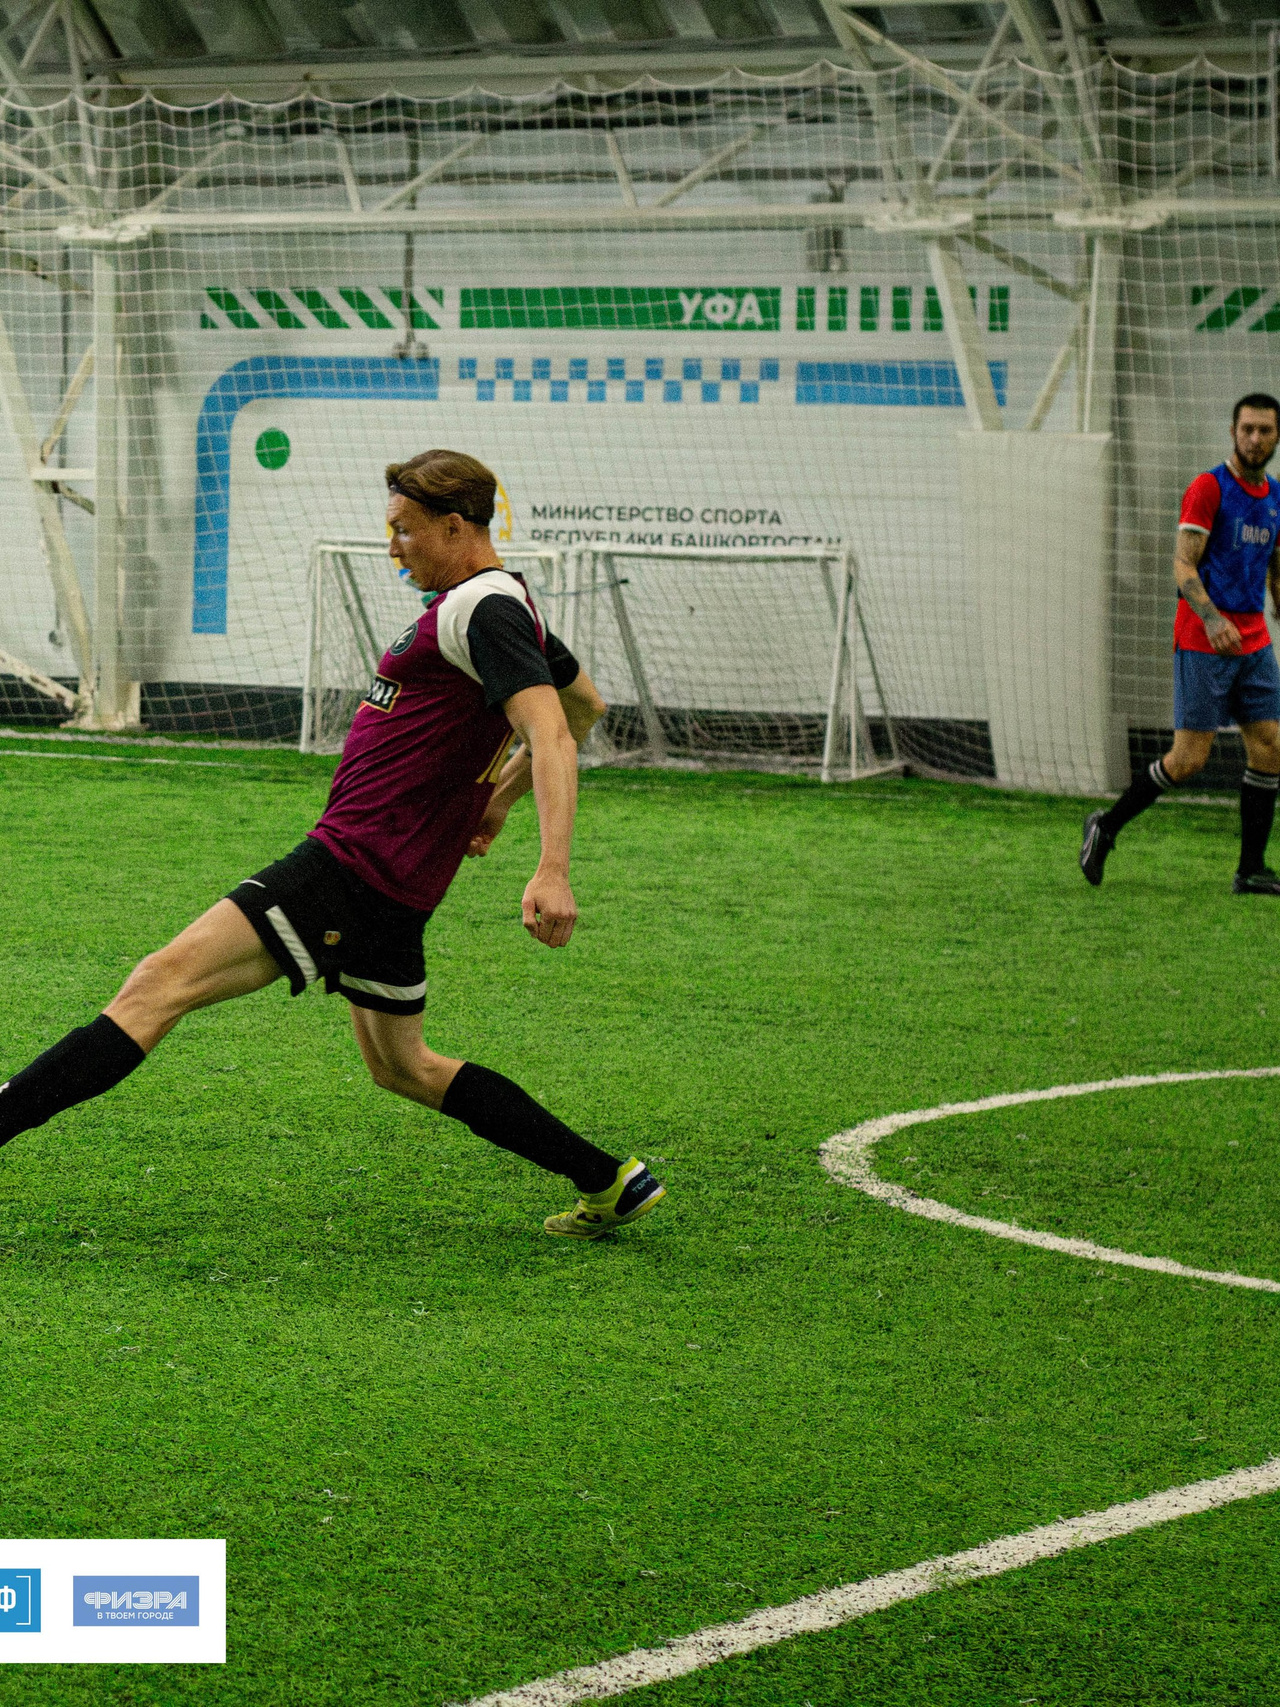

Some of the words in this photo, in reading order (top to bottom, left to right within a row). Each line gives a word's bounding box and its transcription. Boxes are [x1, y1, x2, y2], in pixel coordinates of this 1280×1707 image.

[678, 291, 763, 325] УФА
[531, 504, 695, 522] МИНИСТЕРСТВО
[700, 507, 782, 524] СПОРТА
